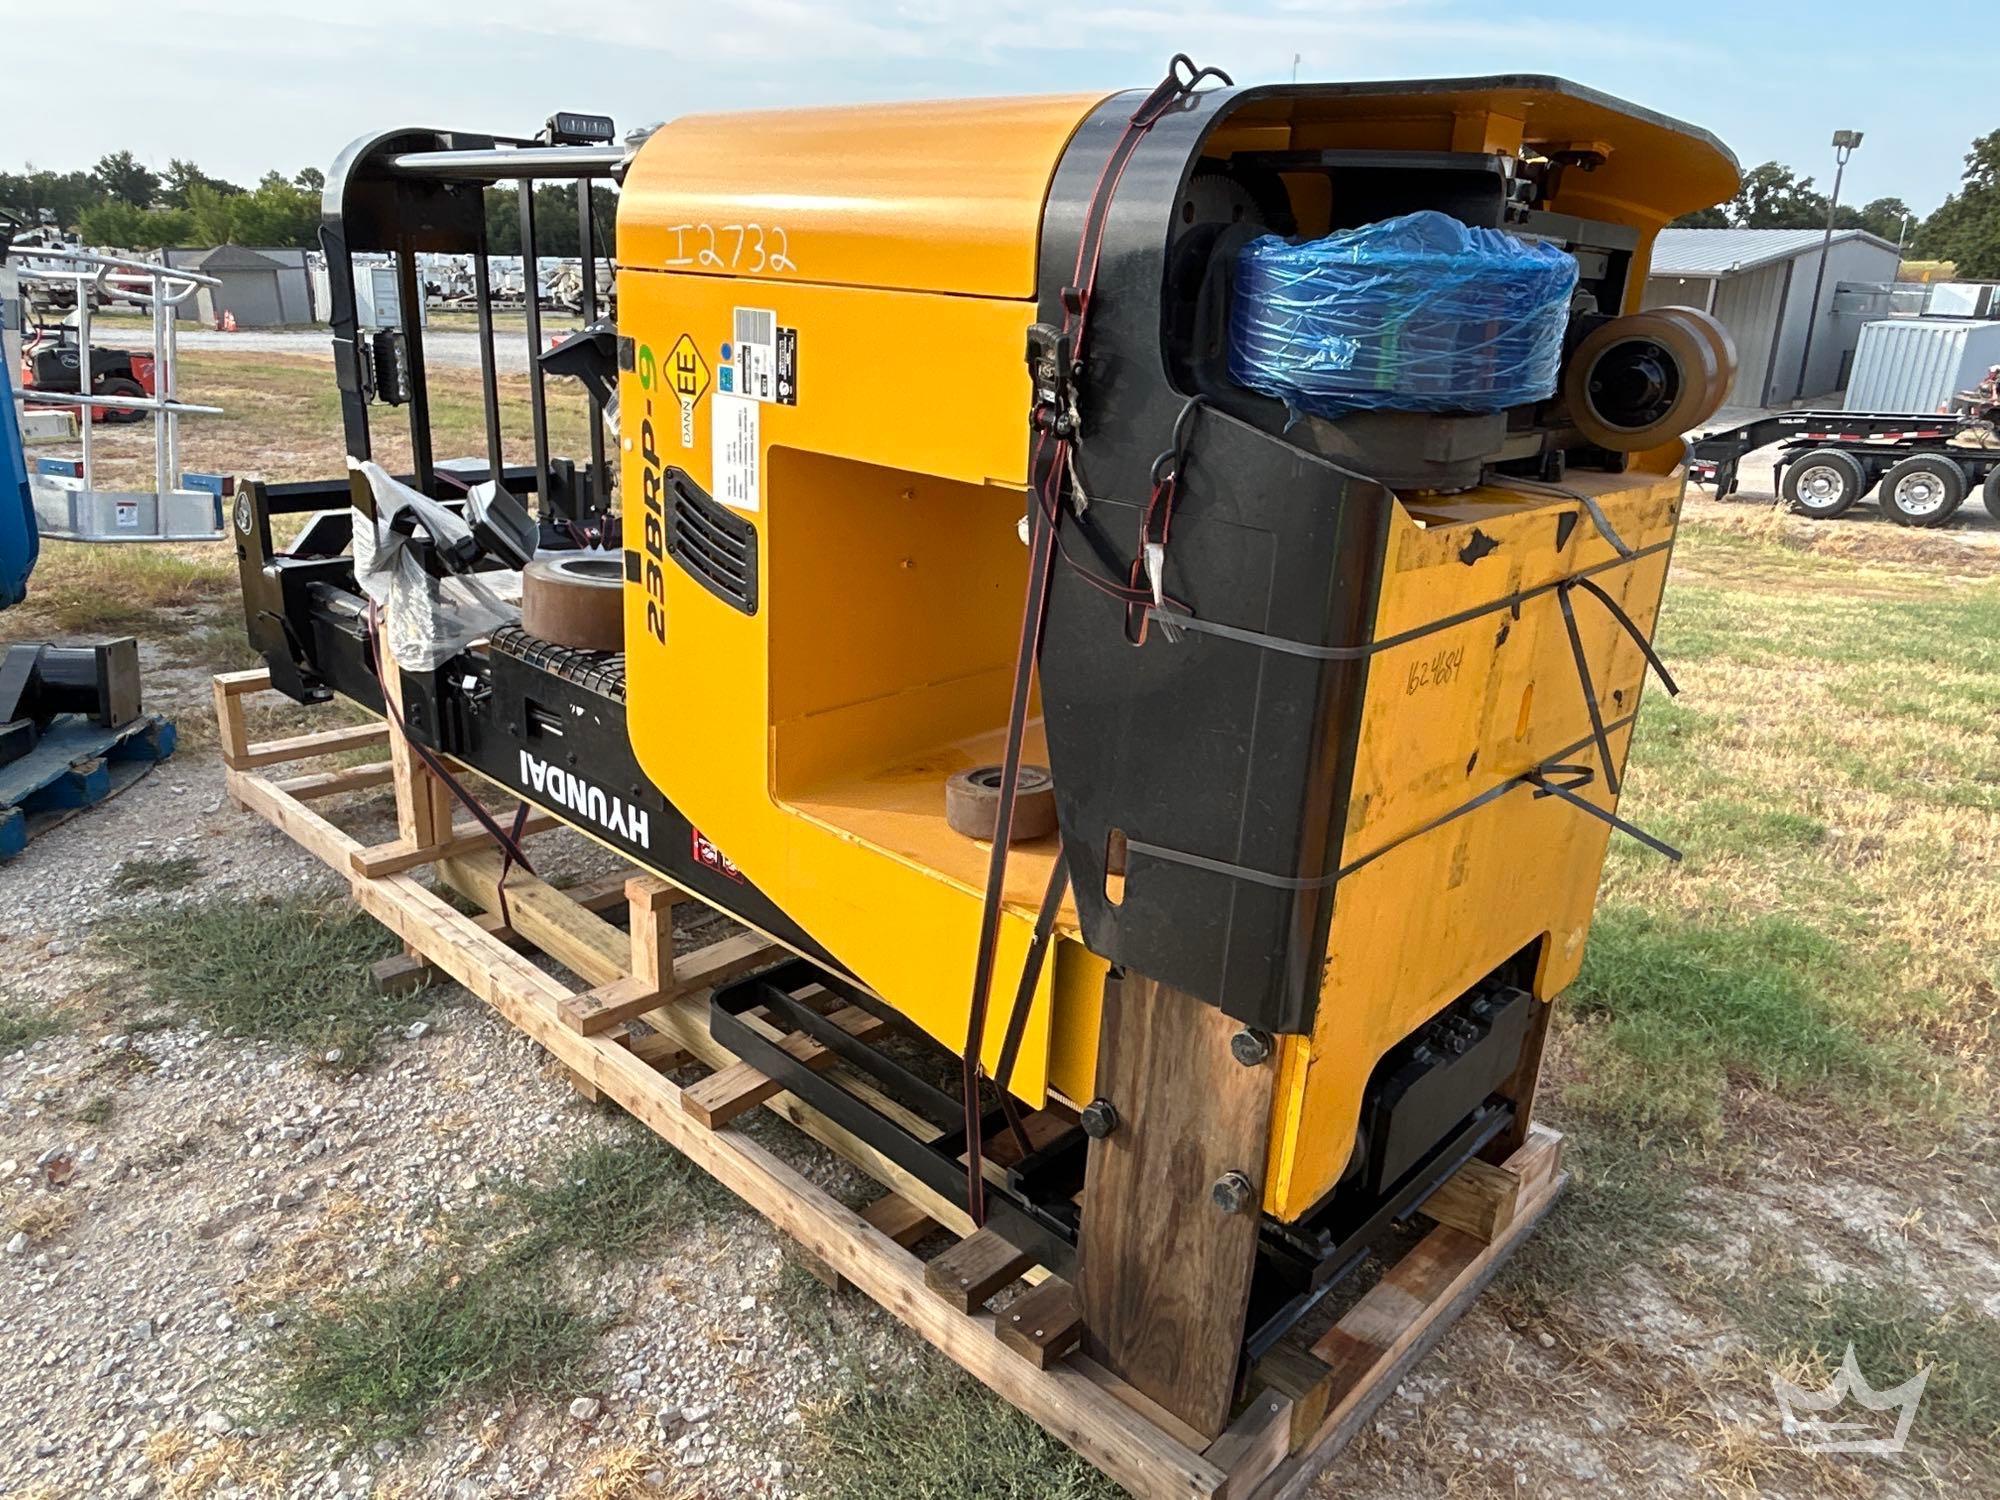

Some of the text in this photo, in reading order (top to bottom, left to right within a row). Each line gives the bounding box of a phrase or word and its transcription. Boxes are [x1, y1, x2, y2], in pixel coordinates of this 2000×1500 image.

[665, 223, 797, 272] I2732
[638, 344, 666, 645] 23BRP-9
[520, 749, 649, 849] HYUNDAI
